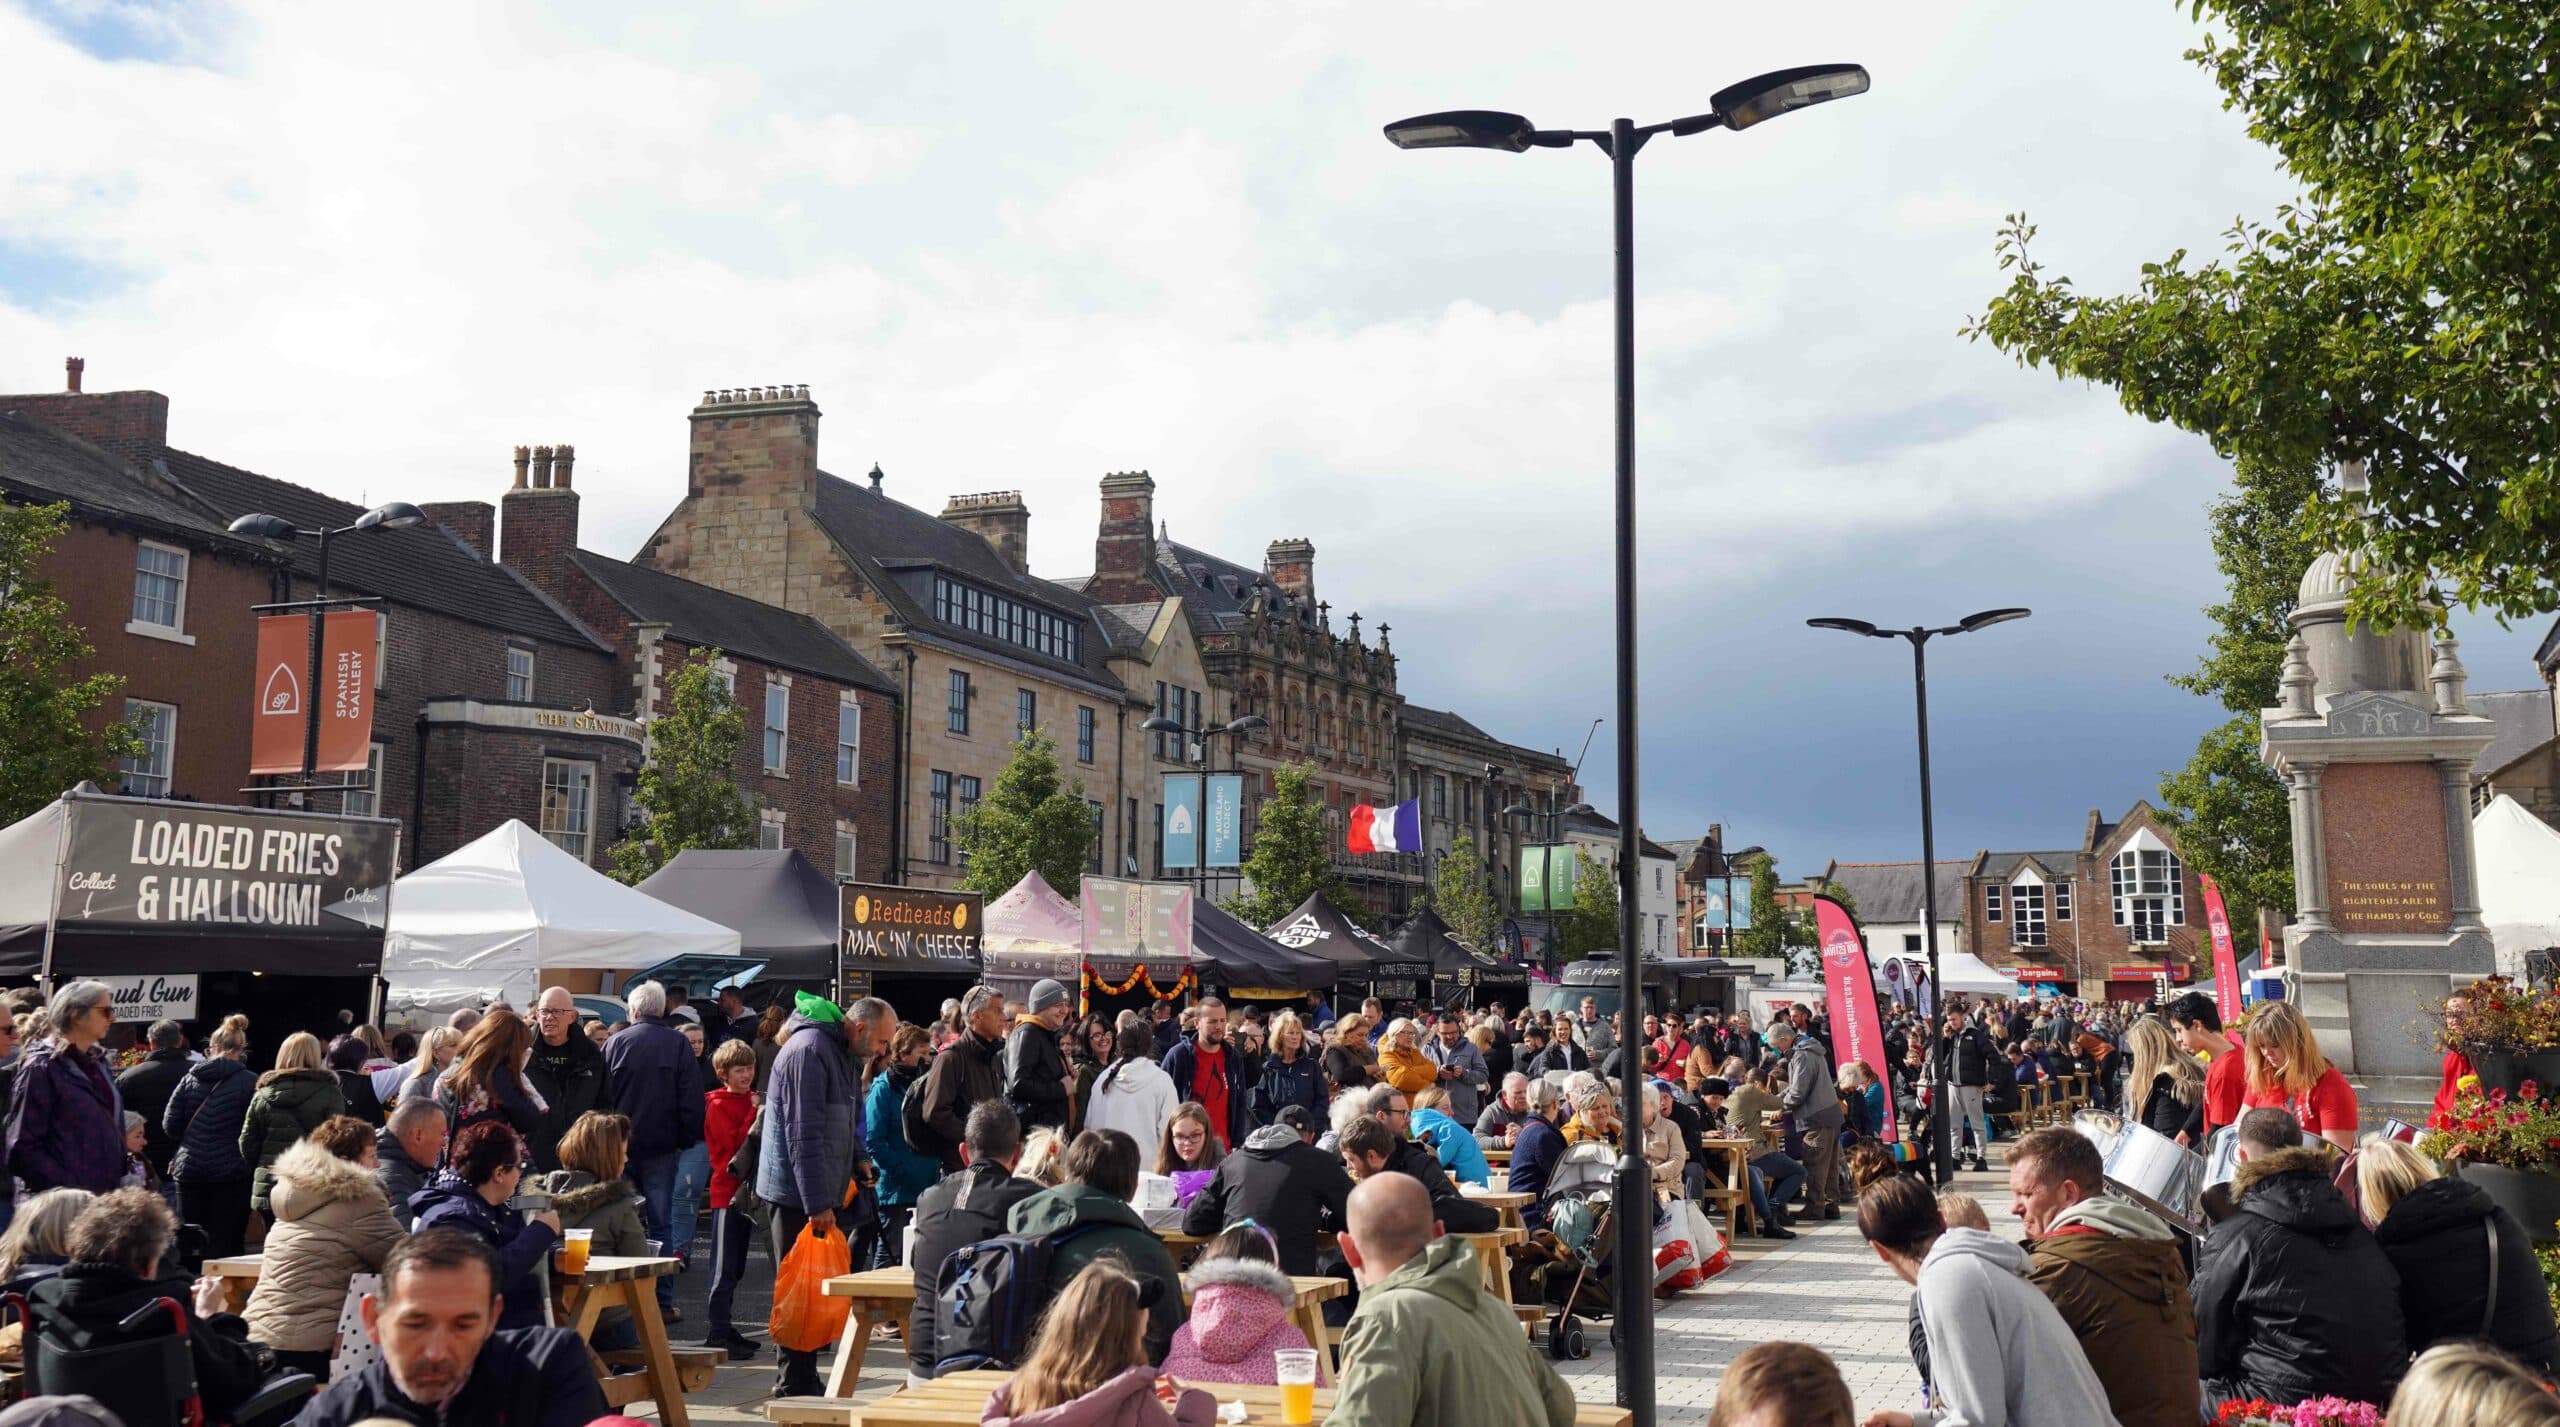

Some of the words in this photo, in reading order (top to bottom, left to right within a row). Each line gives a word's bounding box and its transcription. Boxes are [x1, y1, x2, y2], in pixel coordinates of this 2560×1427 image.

[336, 652, 349, 718] SPANISH
[349, 651, 362, 719] GALLERY
[537, 712, 568, 727] THE
[575, 716, 623, 735] STANLEY
[1215, 785, 1224, 833] AUCKLAND
[1223, 799, 1232, 840] PROJECT
[130, 819, 254, 871] LOADED
[260, 829, 342, 876] FRIES
[1215, 837, 1223, 854] THE
[69, 872, 116, 891] Collect
[2365, 882, 2397, 891] SOULS
[2400, 882, 2411, 891] OF
[2416, 882, 2437, 891] THE
[137, 875, 160, 921] &
[169, 877, 321, 926] HALLOUMI
[344, 887, 382, 904] Order
[2343, 897, 2399, 905] RIGHTEOUS
[2402, 897, 2423, 905] ARE
[2426, 897, 2437, 905] IN
[872, 899, 952, 926] Redheads
[2345, 912, 2366, 920] THE
[2367, 912, 2401, 920] HANDS
[2404, 912, 2415, 920] OF
[1268, 928, 1332, 940] ALPINE
[846, 929, 888, 957] MAC
[915, 933, 975, 960] CHEESE
[1379, 964, 1397, 975] ALPINE
[1397, 963, 1414, 975] STREET
[1414, 964, 1429, 975] FOOD
[1566, 967, 1591, 977] FAT
[1592, 967, 1622, 977] HIPP
[2022, 969, 2058, 978] bargains
[109, 978, 146, 1004] ud
[150, 976, 194, 1003] Gun
[112, 1006, 140, 1018] OADED
[141, 1004, 164, 1018] FRIES
